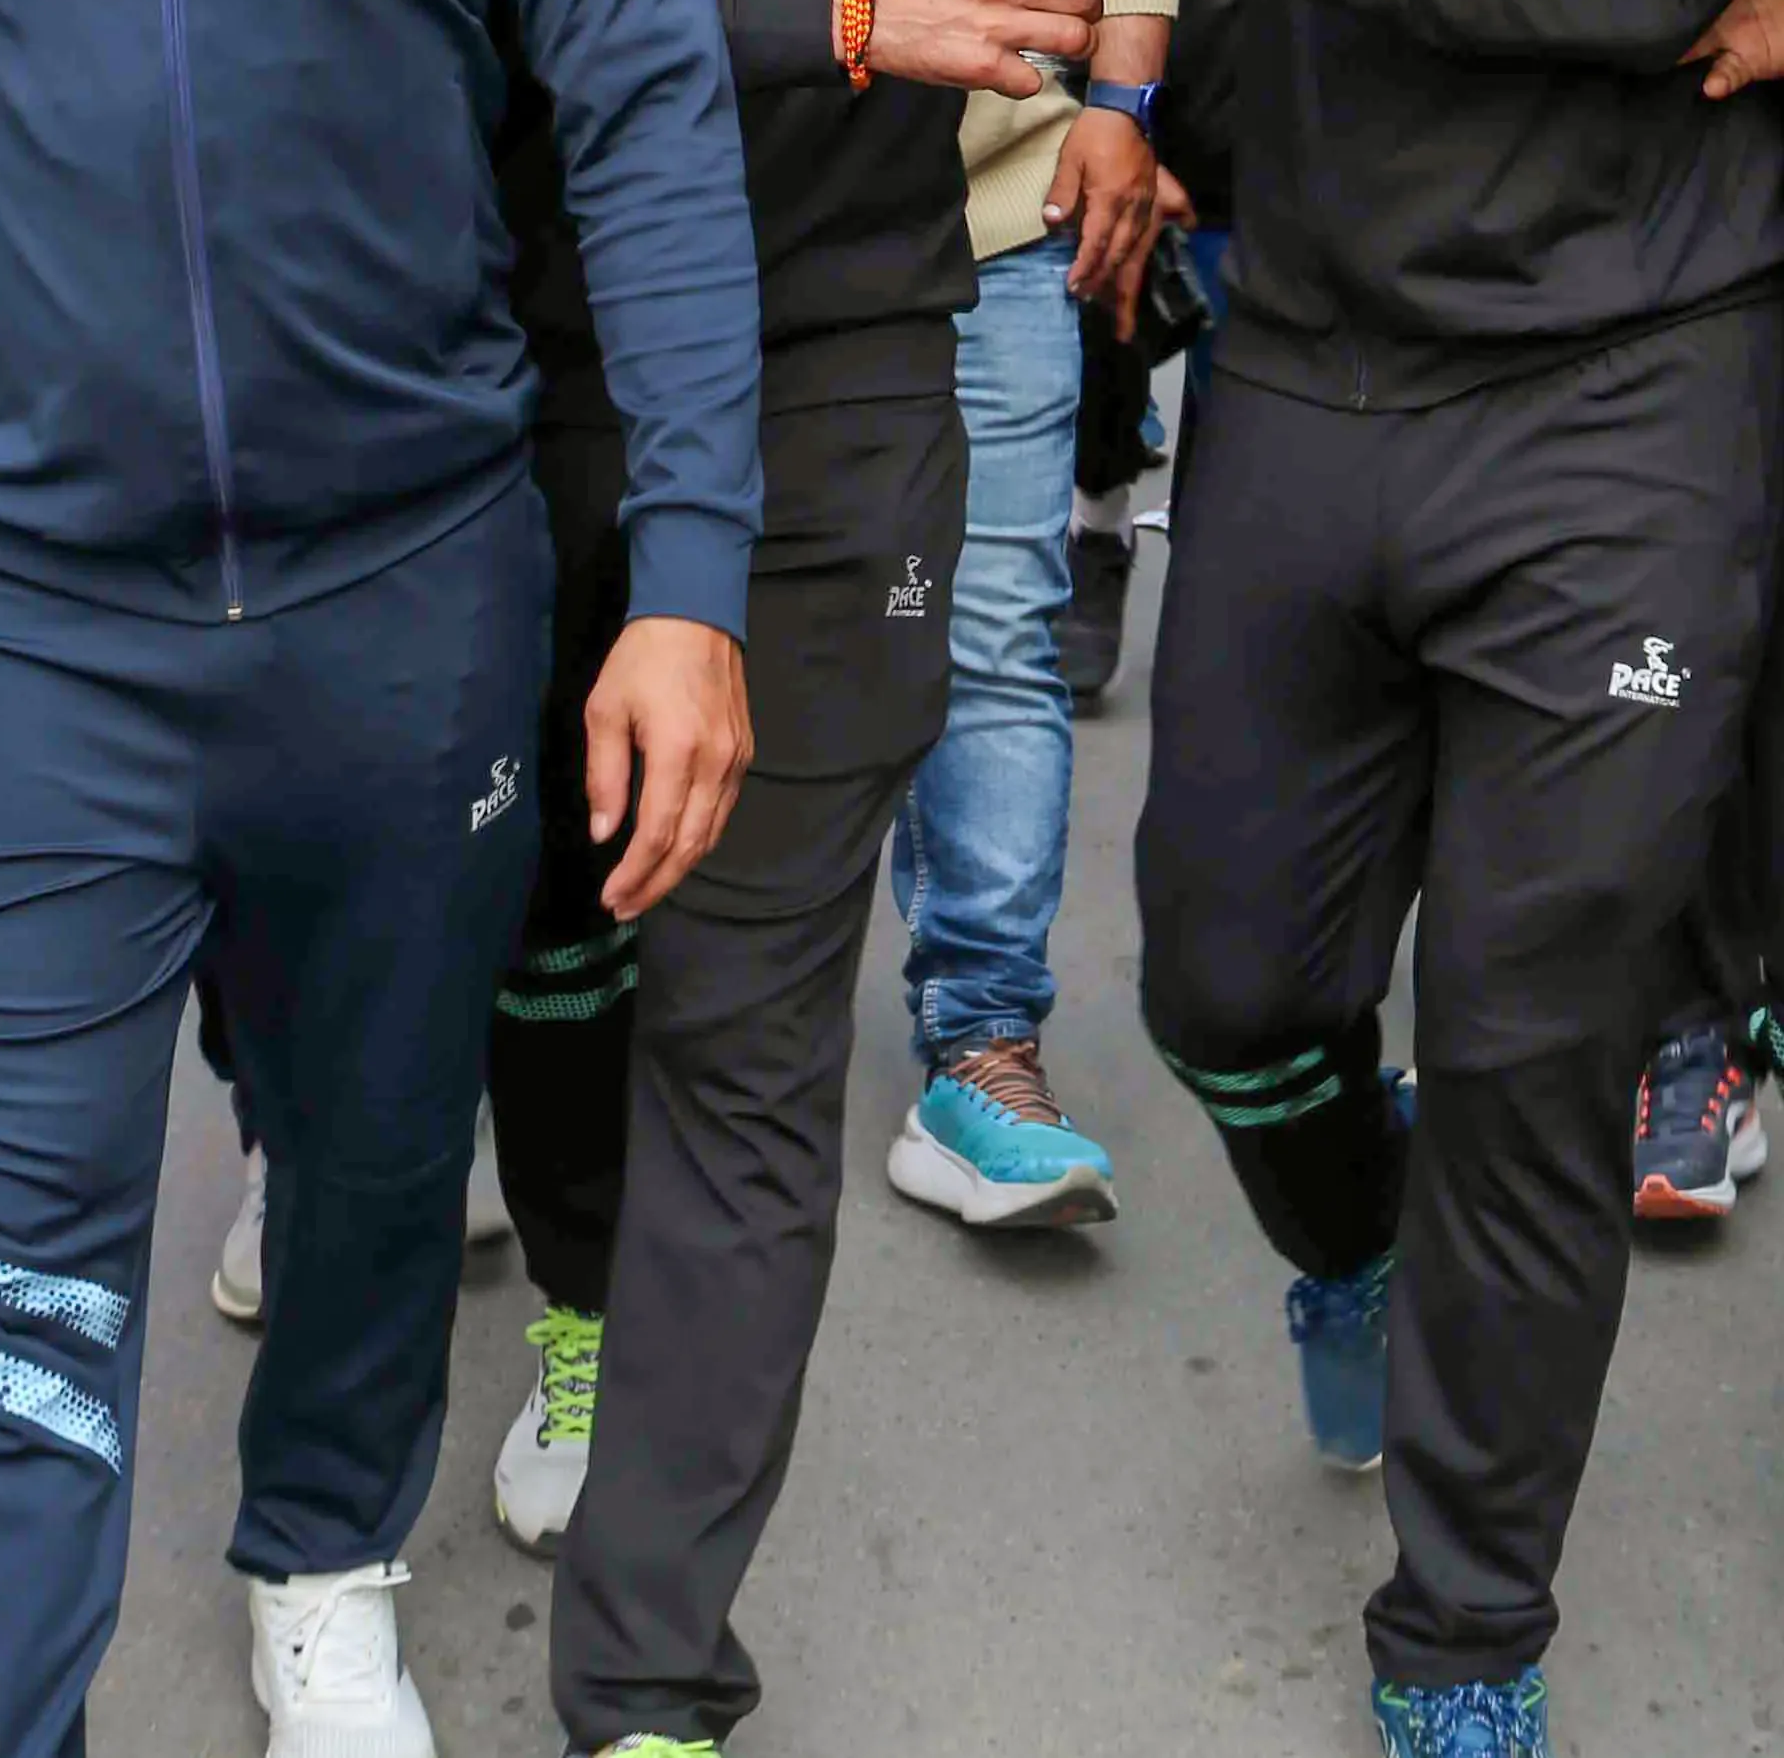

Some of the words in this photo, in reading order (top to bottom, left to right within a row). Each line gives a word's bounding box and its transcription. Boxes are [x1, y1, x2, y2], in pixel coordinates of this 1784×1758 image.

[884, 585, 925, 617] PACE
[1608, 661, 1682, 697] PACE
[470, 772, 516, 832] PACE
